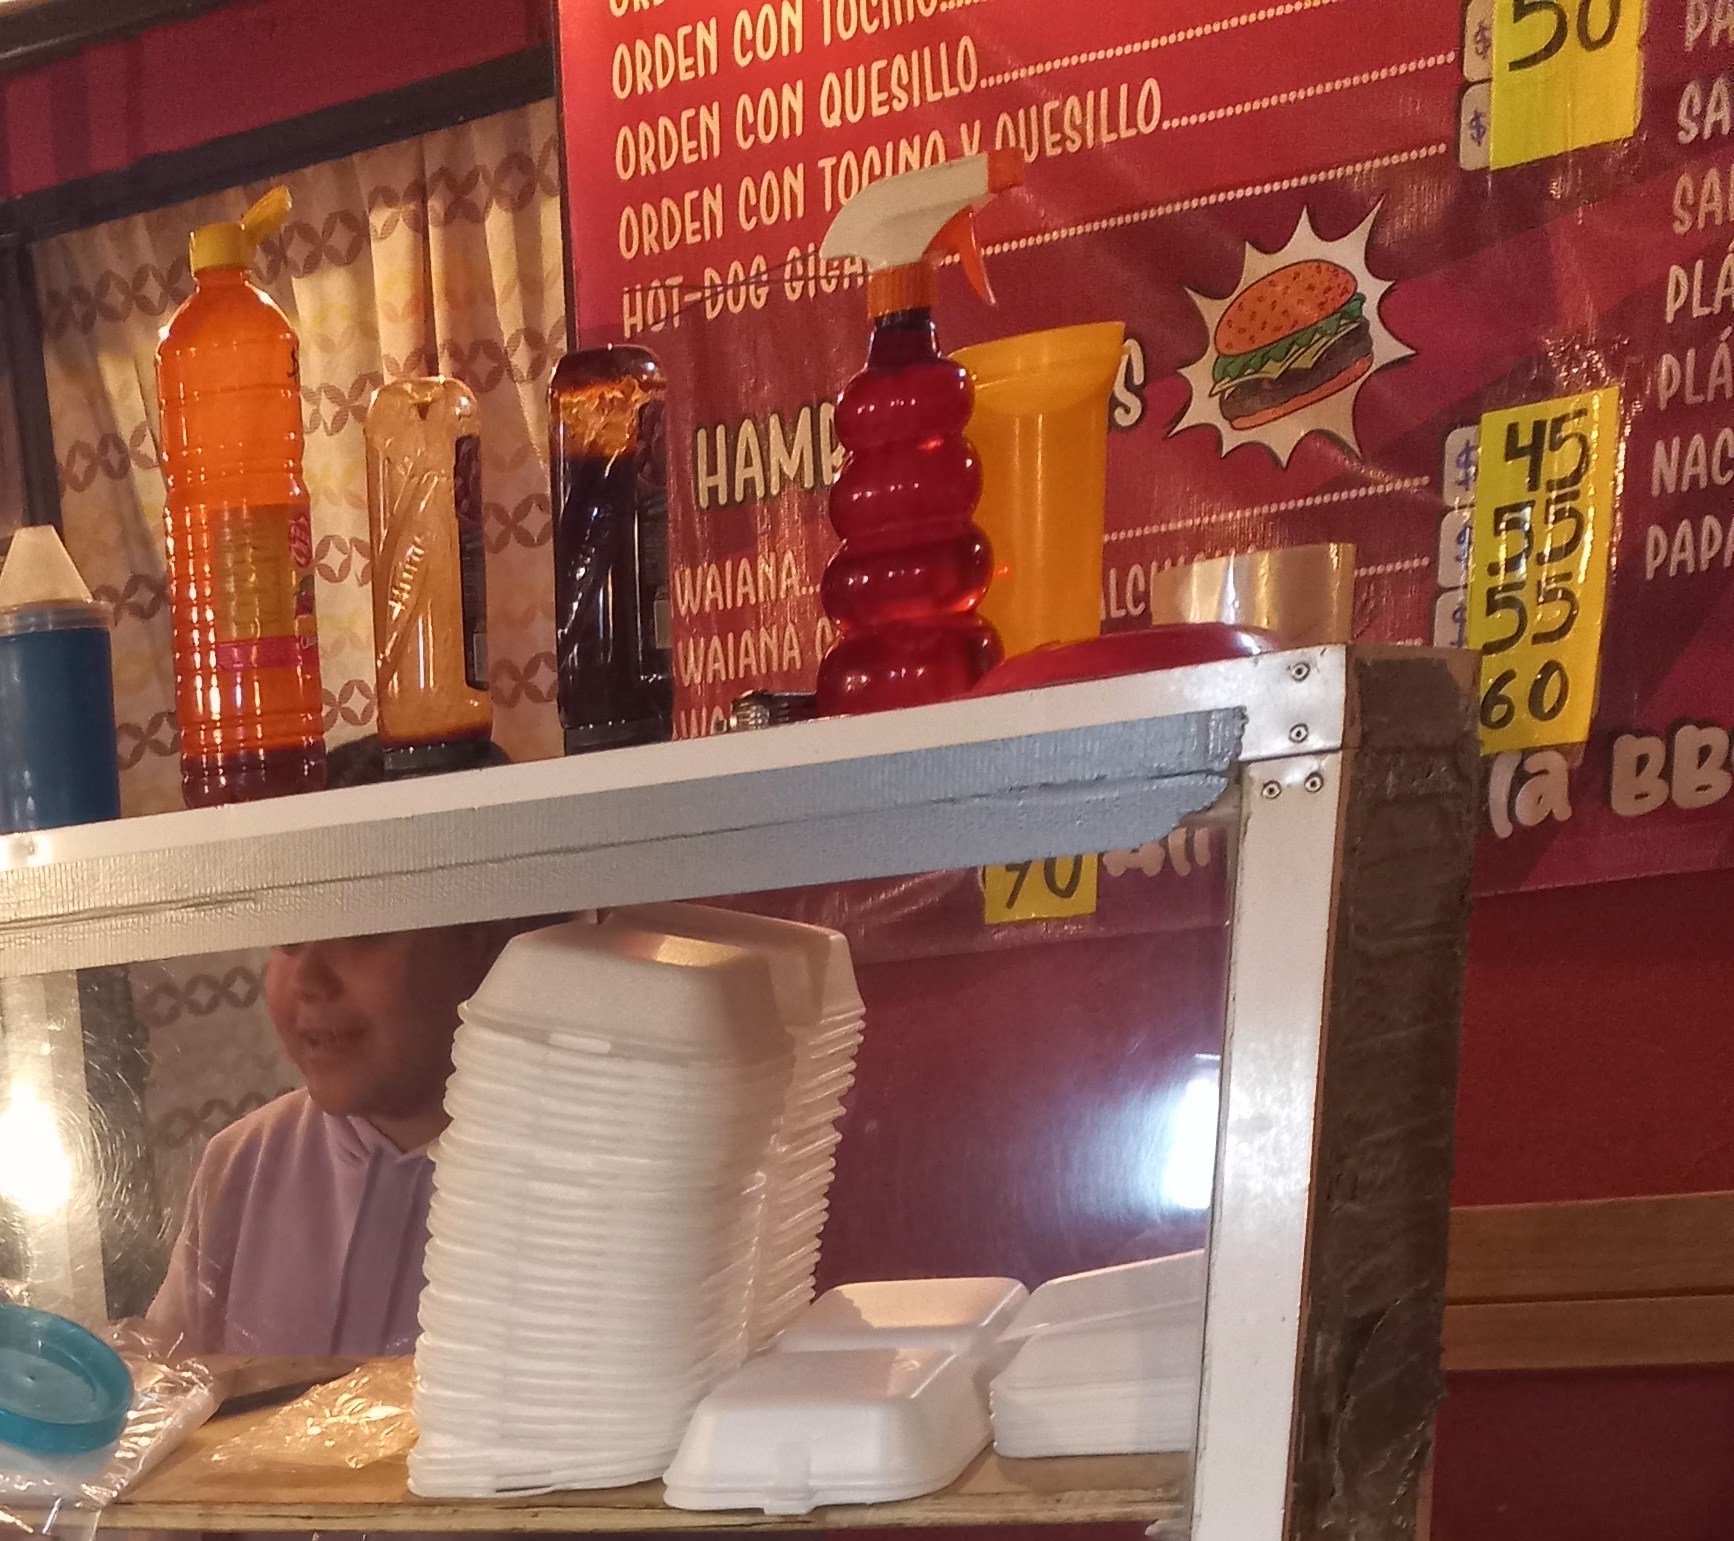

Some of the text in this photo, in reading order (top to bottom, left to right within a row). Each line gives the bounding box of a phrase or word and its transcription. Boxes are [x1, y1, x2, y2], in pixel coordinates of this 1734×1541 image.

[612, 16, 718, 100] ORDEN
[733, 0, 804, 67] CON
[1508, 0, 1620, 72] 50
[615, 35, 978, 181] ORDEN CON QUESILLO
[618, 182, 724, 260] ORDEN
[738, 163, 806, 232] CON
[994, 77, 1162, 165] QUESILLO
[622, 254, 770, 340] HOT-DOG
[1504, 408, 1592, 493] 45
[1487, 488, 1588, 578] 55
[1480, 573, 1580, 656] 55
[1479, 658, 1571, 731] 60
[1611, 724, 1734, 817] BB
